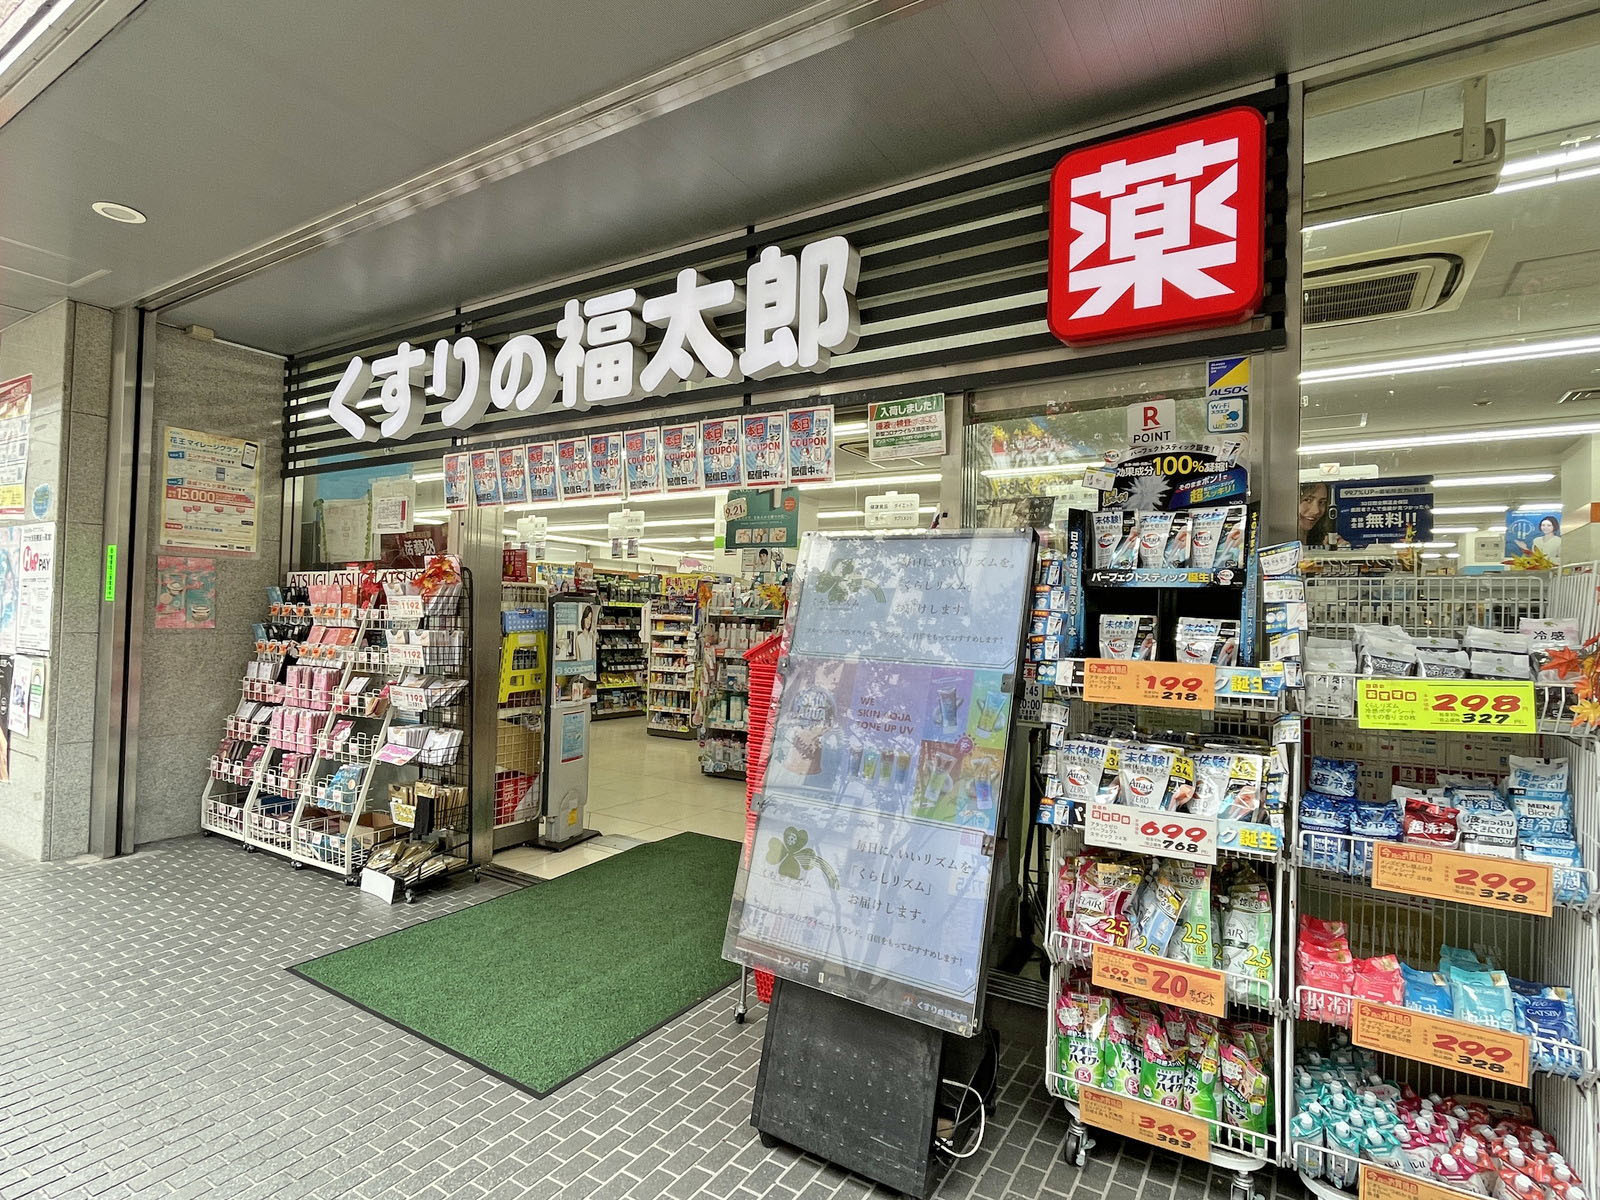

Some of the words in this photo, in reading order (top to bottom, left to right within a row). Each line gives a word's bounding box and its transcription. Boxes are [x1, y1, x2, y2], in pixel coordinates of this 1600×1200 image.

[1068, 137, 1239, 321] 薬
[328, 235, 853, 442] くすりの福太郎
[1209, 386, 1248, 396] ALSOK
[880, 401, 936, 417] 入荷しました!
[791, 417, 810, 430] 本日
[1143, 407, 1161, 427] R
[746, 423, 765, 436] 本日
[791, 437, 826, 447] COUPON
[1133, 431, 1171, 443] POINT
[704, 446, 737, 455] COUPON
[746, 442, 780, 452] COUPON
[628, 455, 655, 464] COUPON
[664, 451, 696, 460] COUPON
[530, 466, 555, 474] COUPON
[560, 463, 588, 471] COUPON
[592, 459, 618, 467] COUPON
[1366, 512, 1417, 528] 無料!!
[39, 558, 51, 571] PAY
[291, 573, 326, 587] ATSUGI
[1534, 630, 1565, 640] 冷感
[1144, 676, 1203, 692] 199
[406, 694, 424, 702] 1192
[861, 697, 875, 706] WE
[1161, 691, 1197, 701] 218
[1432, 694, 1521, 712] 298
[858, 708, 880, 718] SKIN
[885, 711, 911, 722] QUA
[1462, 713, 1510, 724] 327
[857, 721, 881, 731] TONE
[884, 724, 896, 733] UP
[900, 726, 914, 735] UV
[1064, 744, 1105, 761] 未体験!
[1125, 752, 1169, 769] 未体験!
[1066, 769, 1089, 780] Attack
[1130, 778, 1154, 791] Attack
[1141, 821, 1207, 843] 699
[1408, 820, 1455, 835] 超洗浄
[1520, 818, 1568, 834] 超冷感
[1162, 840, 1199, 853] 768
[1453, 868, 1536, 893] 299
[1080, 895, 1102, 910] FLAIR
[1479, 889, 1528, 904] 328
[848, 895, 927, 924] お届けします。
[1105, 919, 1130, 936] 2.5
[1182, 922, 1208, 944] 2.5
[1244, 945, 1272, 968] 2.5
[1101, 966, 1129, 977] 499
[1152, 970, 1188, 998] 20
[1189, 989, 1215, 1000] ポイント
[1526, 1008, 1562, 1017] GATSBY
[1432, 1034, 1512, 1062] 299
[1457, 1055, 1505, 1073] 328
[1078, 1071, 1088, 1079] EX
[1156, 1072, 1184, 1083] ワイド
[1138, 1116, 1196, 1141] 349
